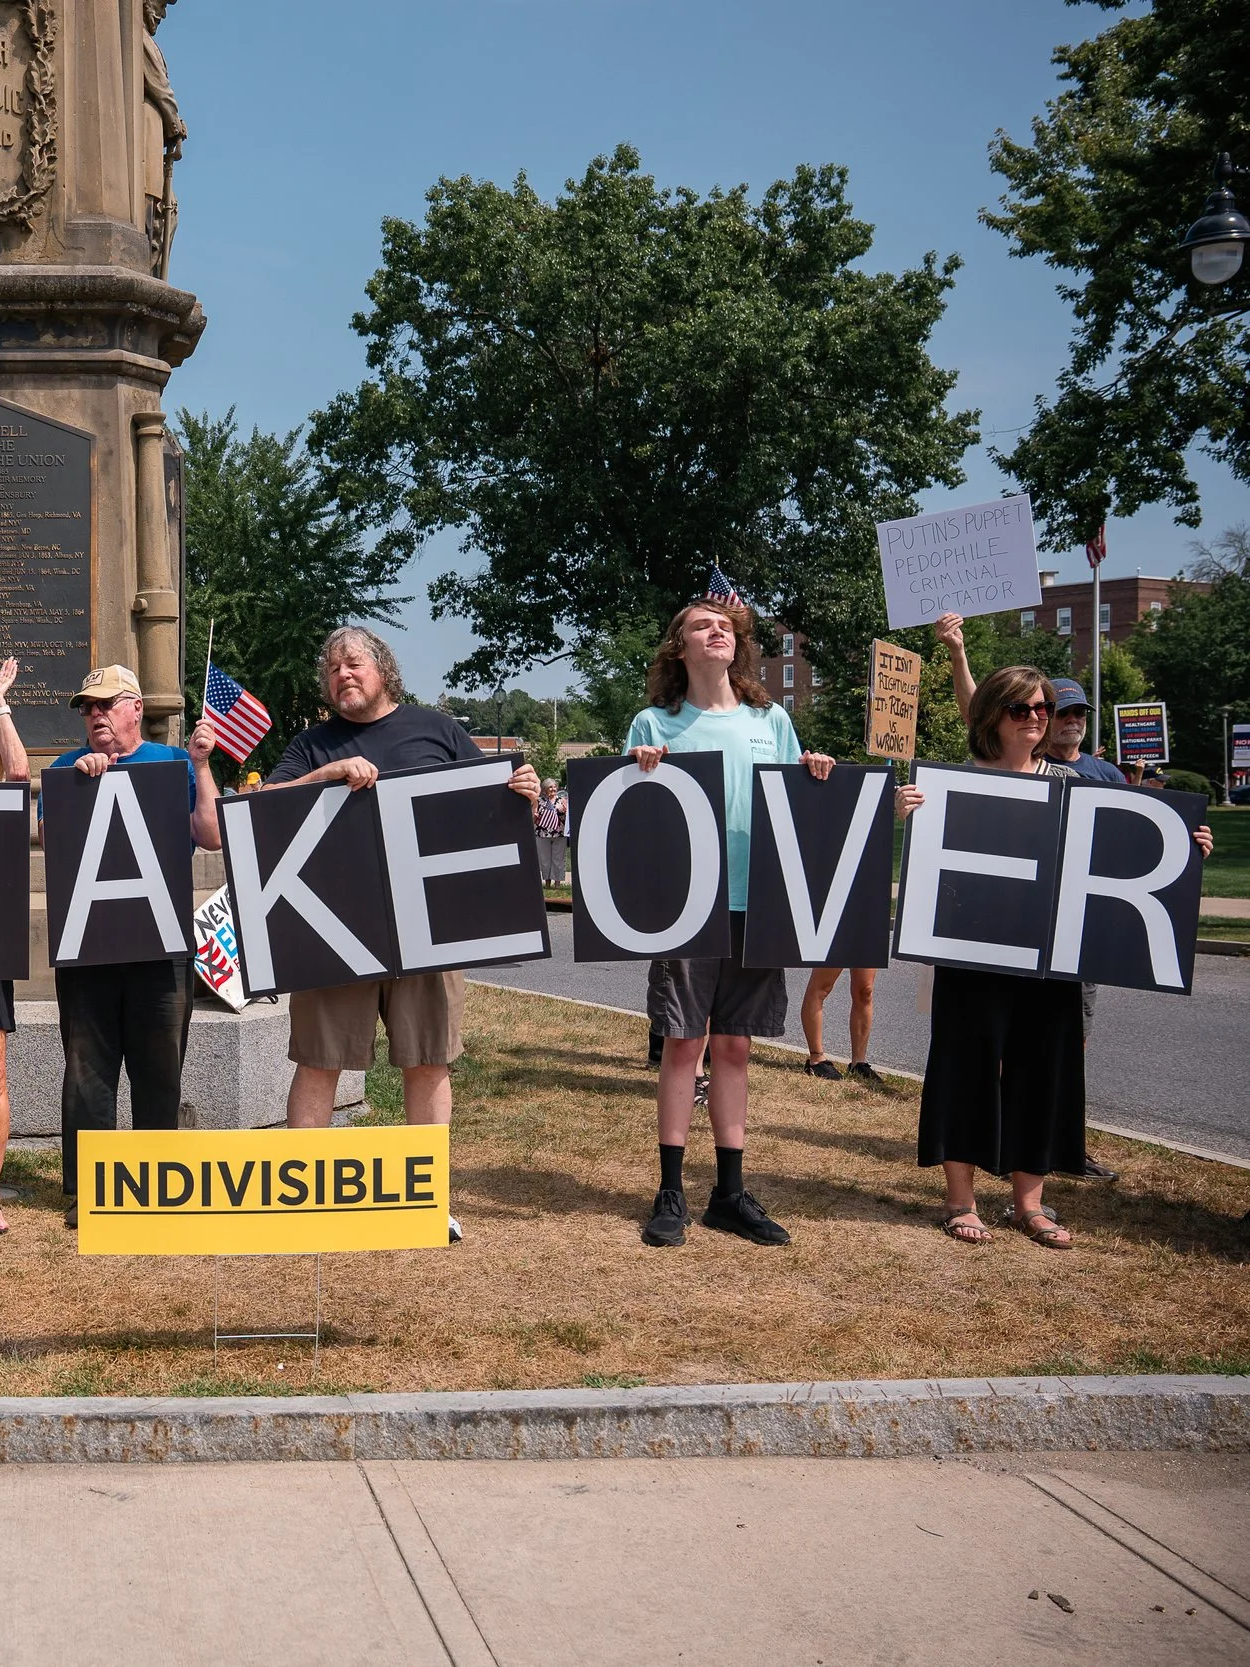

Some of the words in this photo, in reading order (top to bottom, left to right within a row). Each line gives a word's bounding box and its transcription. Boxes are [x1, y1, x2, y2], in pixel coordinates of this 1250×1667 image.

[17, 455, 66, 467] UNION
[886, 517, 960, 554] PUTIN'S
[965, 503, 1023, 534] PUPPET
[895, 536, 1009, 578] PEDOPHILE
[909, 563, 1009, 594] CRIMINAL
[920, 580, 1015, 616] DICTATOR
[879, 652, 893, 671] IT
[878, 672, 900, 691] RIGHT
[889, 695, 913, 720] RIGHT
[1119, 709, 1138, 717] HANDS
[1139, 708, 1149, 716] OFF
[95, 1156, 434, 1207] INDIVISIBLE
